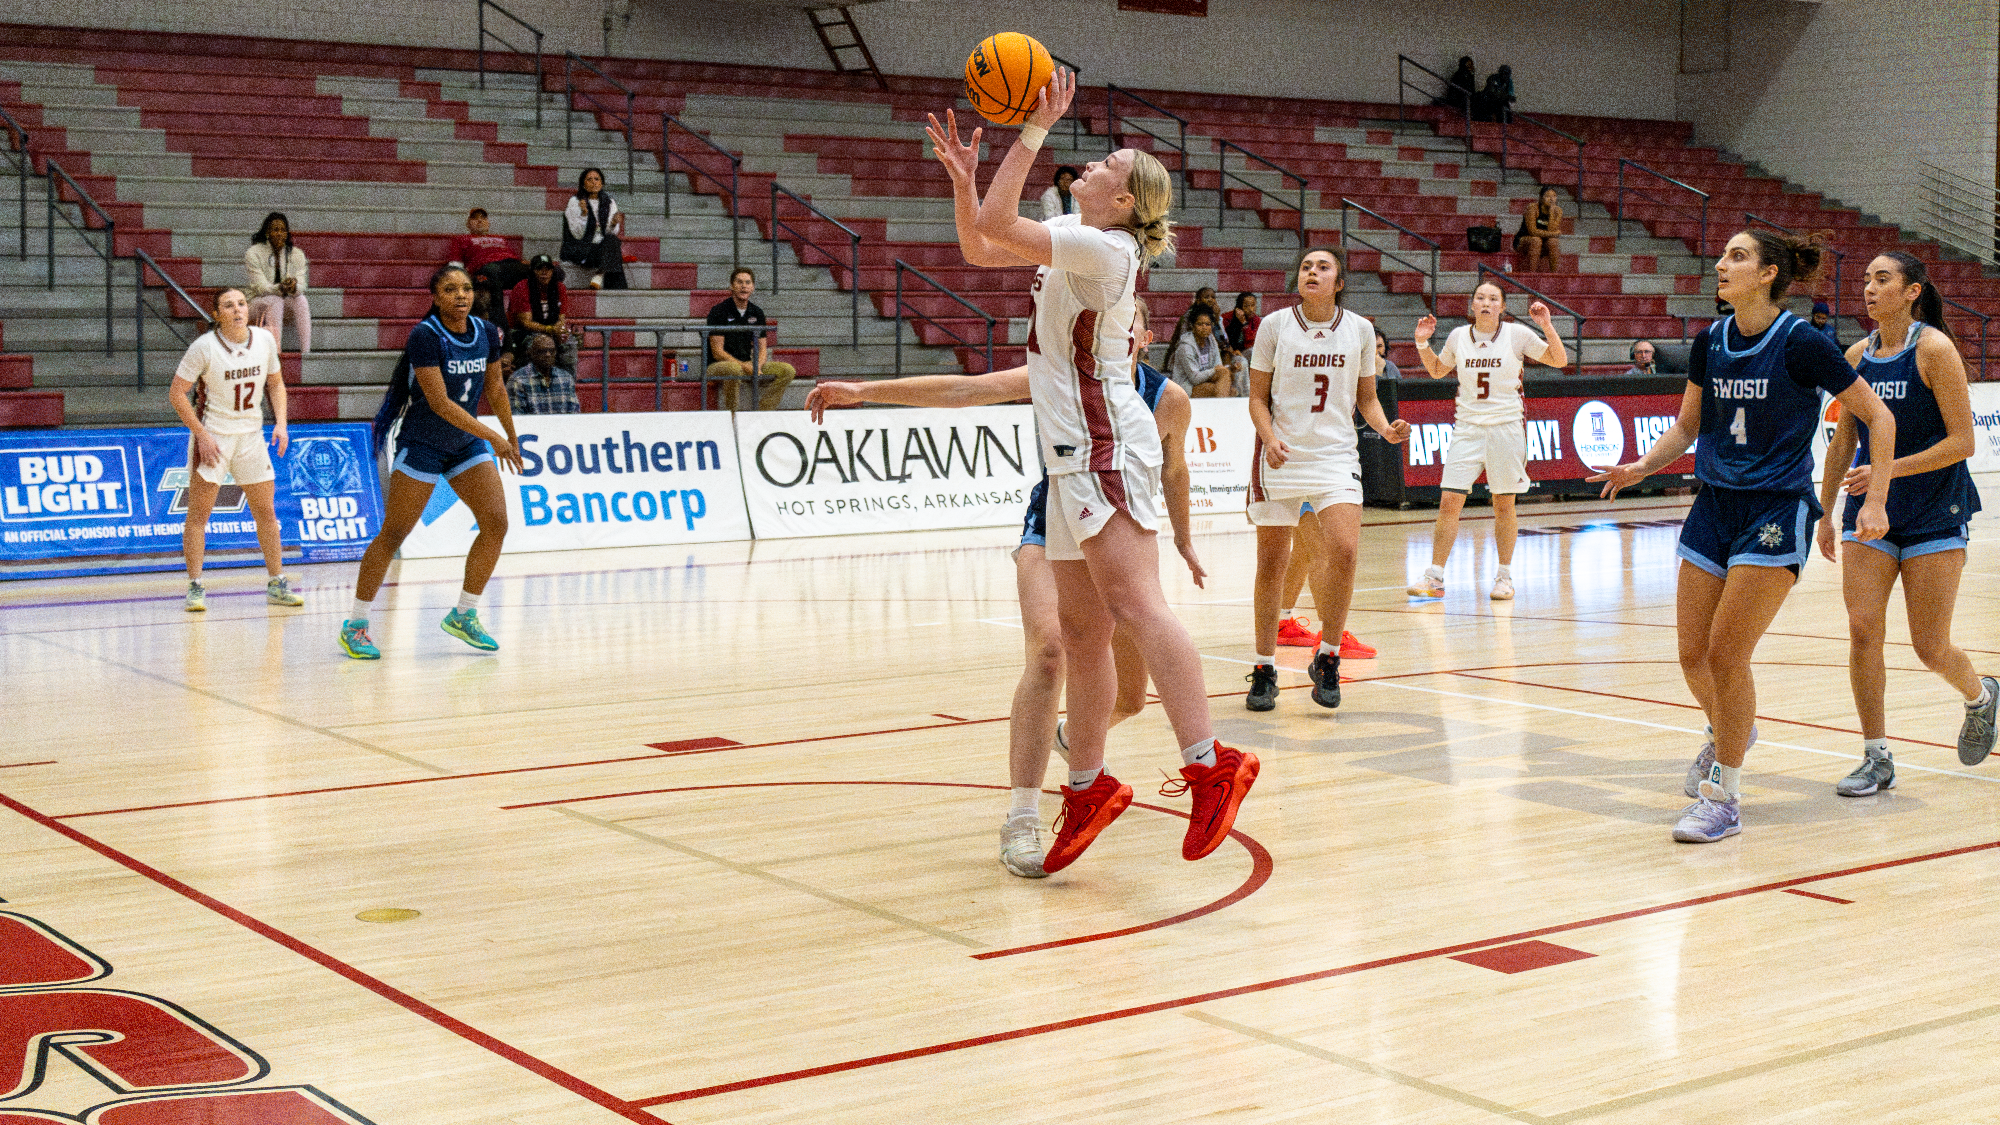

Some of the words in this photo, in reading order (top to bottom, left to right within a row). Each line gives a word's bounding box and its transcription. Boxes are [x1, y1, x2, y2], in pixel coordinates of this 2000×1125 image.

[225, 366, 260, 380] REDDIES
[447, 357, 487, 374] SWOSU
[1294, 353, 1346, 368] REDDIES
[1465, 358, 1502, 368] REDDIES
[234, 382, 255, 411] 12
[1311, 373, 1329, 413] 3
[1477, 372, 1490, 400] 5
[1729, 407, 1747, 444] 4
[518, 430, 721, 477] Southern
[755, 424, 1025, 488] OAKLAWN
[19, 455, 103, 485] BUD
[5, 482, 121, 514] LIGHT
[301, 497, 358, 519] BUD
[519, 484, 707, 531] Bancorp
[776, 500, 816, 516] HOT
[824, 494, 918, 514] SPRINGS,
[923, 489, 1024, 510] ARKANSAS
[4, 531, 20, 542] AN
[19, 528, 67, 542] OFFICIAL
[68, 526, 117, 539] SPONSOR
[118, 525, 131, 537] OF
[132, 524, 153, 537] THE
[212, 521, 241, 533] STATE
[298, 518, 367, 541] LIGHT
